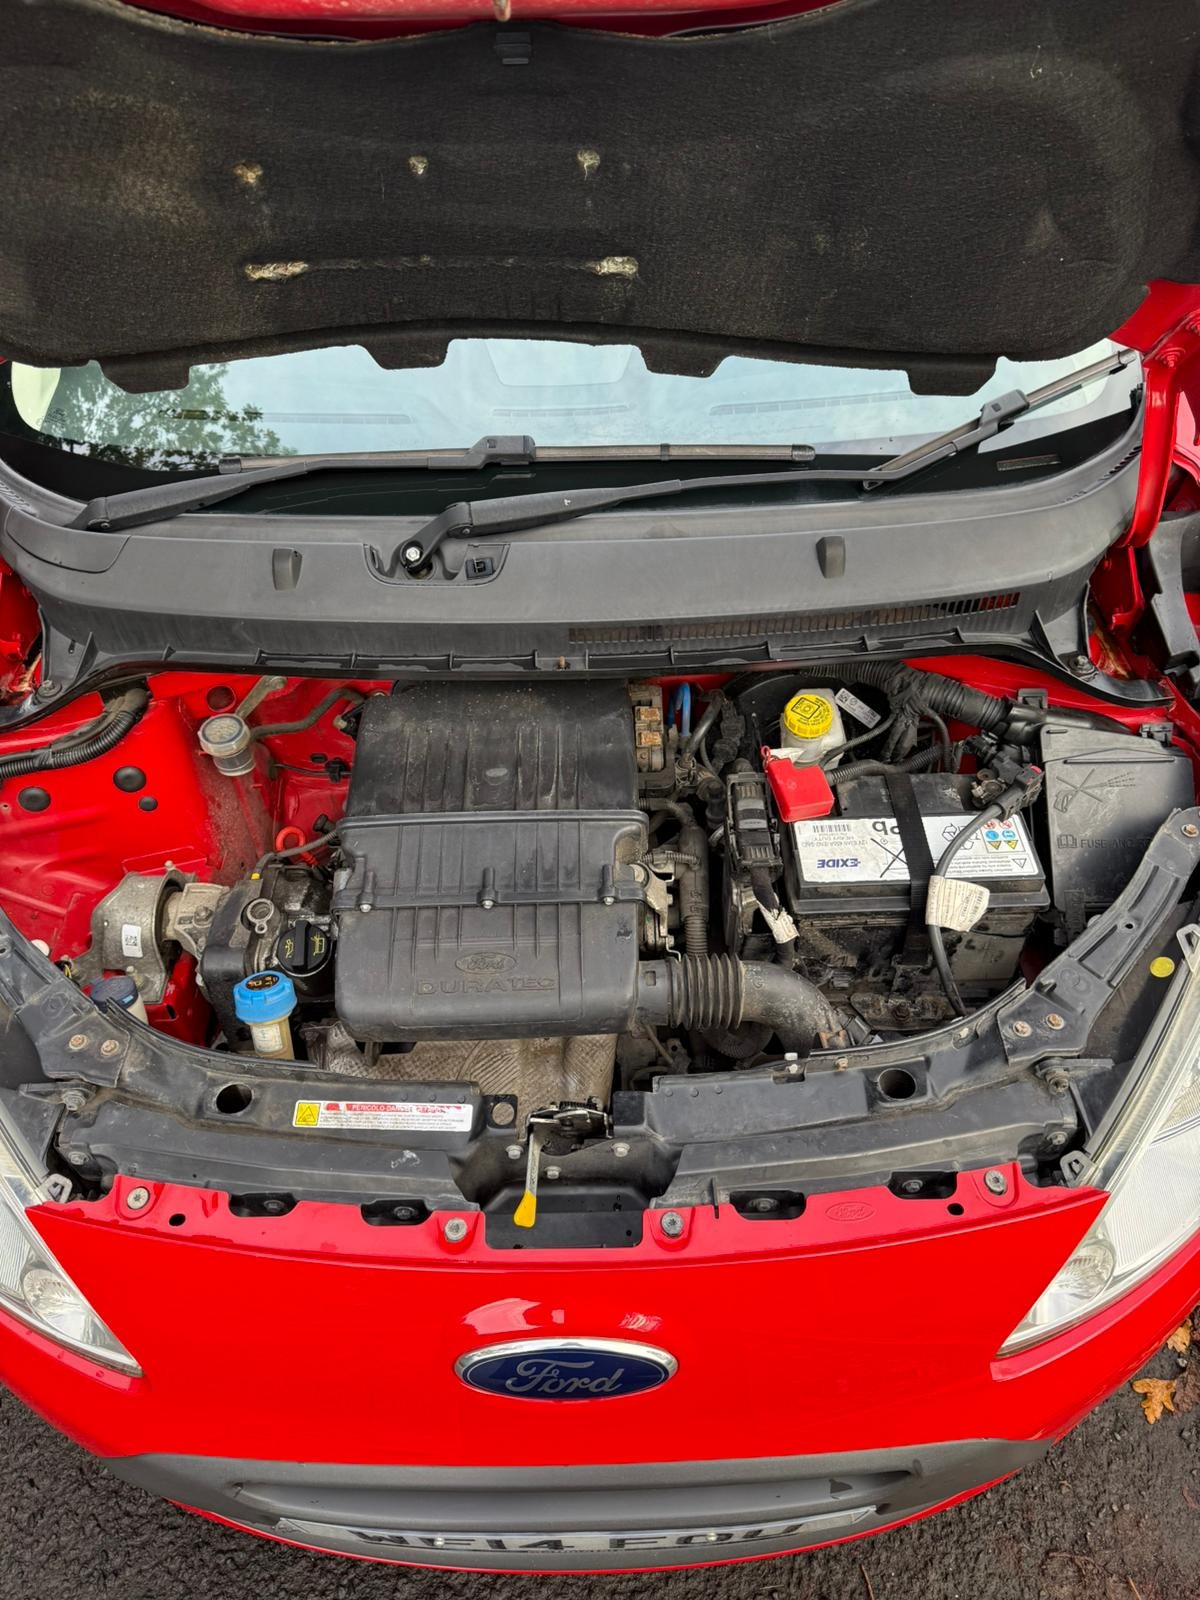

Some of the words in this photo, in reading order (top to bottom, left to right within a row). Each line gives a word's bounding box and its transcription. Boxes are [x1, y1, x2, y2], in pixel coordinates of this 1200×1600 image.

[1080, 839, 1107, 848] FUSE
[817, 858, 861, 869] EXIDE
[417, 976, 556, 996] DURATEC
[505, 1358, 625, 1393] Ford
